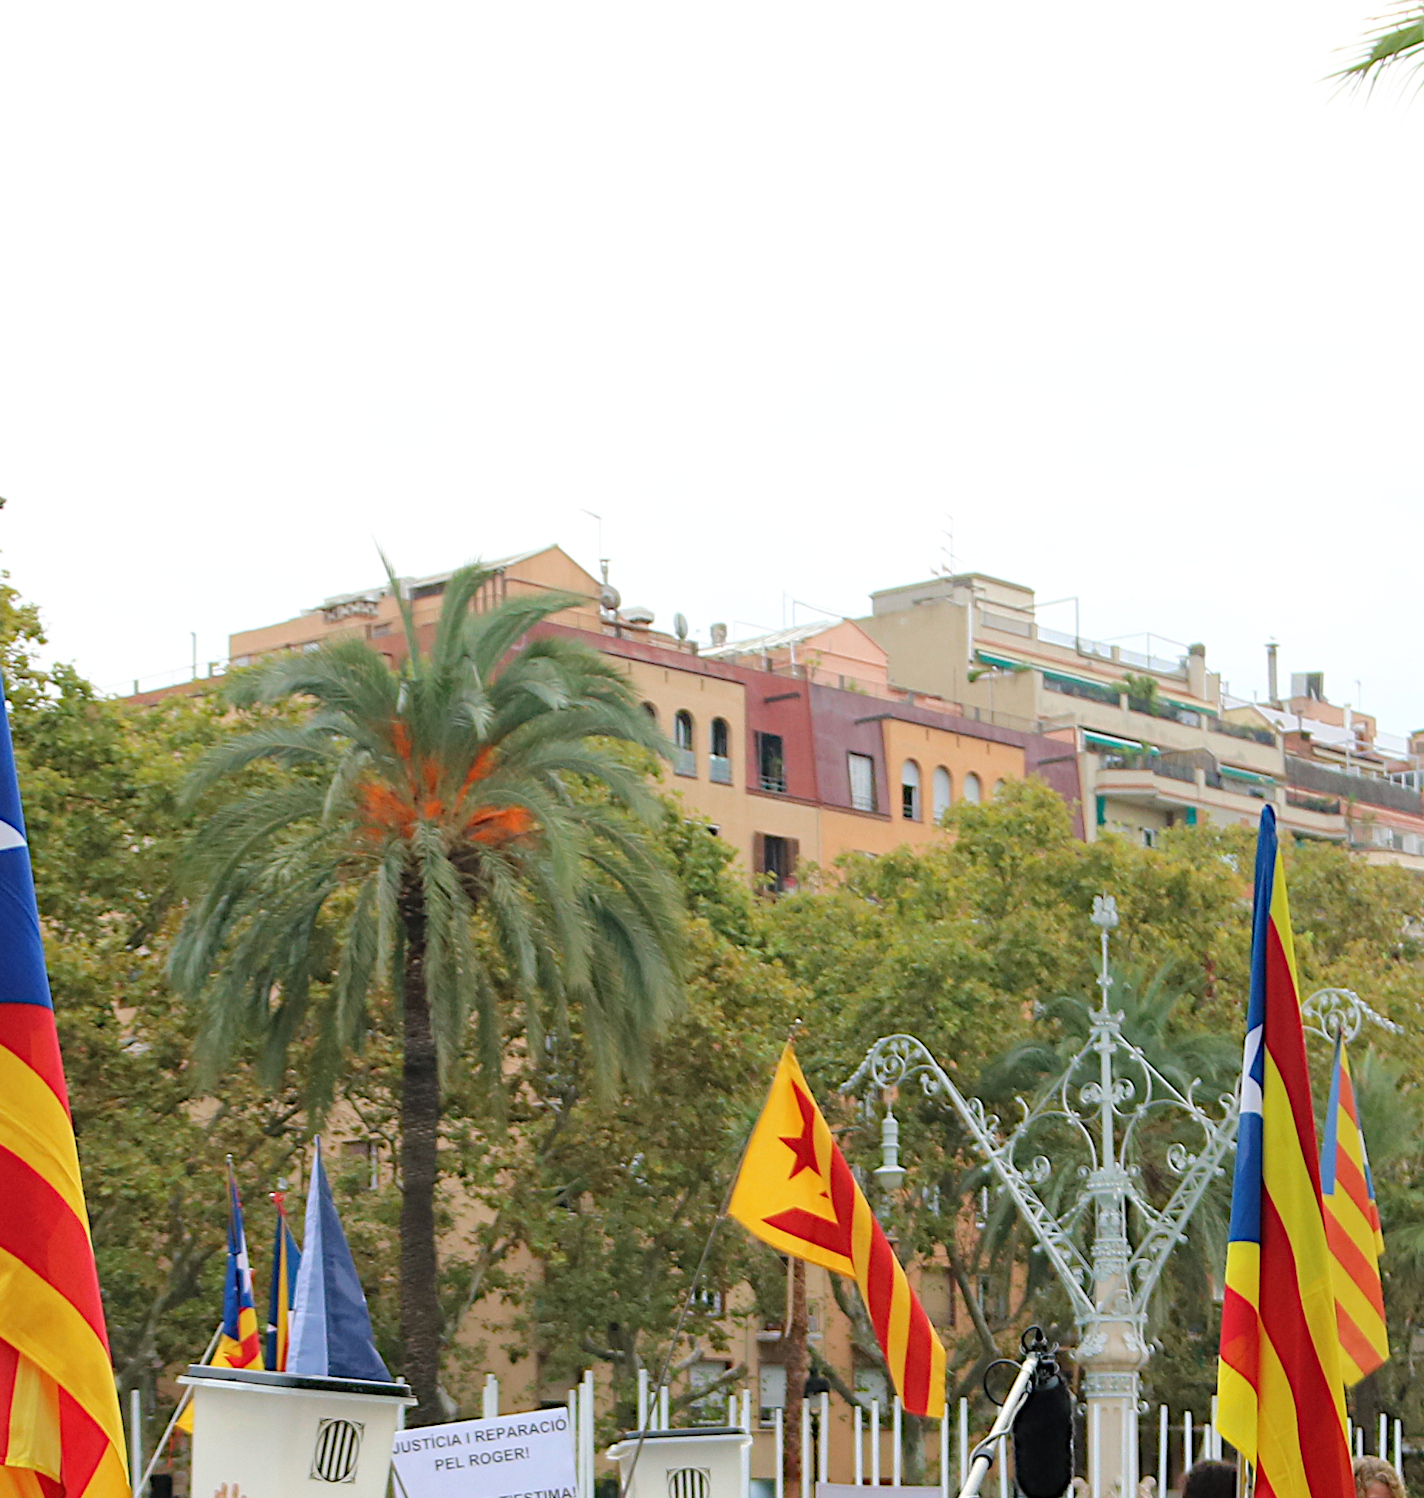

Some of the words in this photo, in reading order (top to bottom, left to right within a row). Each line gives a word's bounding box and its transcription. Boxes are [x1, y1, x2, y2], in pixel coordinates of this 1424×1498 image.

[392, 1433, 461, 1455] JUSTÍCIA
[466, 1432, 471, 1444] I
[475, 1415, 567, 1443] REPARACIÓ
[435, 1457, 465, 1472] PEL
[469, 1447, 531, 1467] ROGER!
